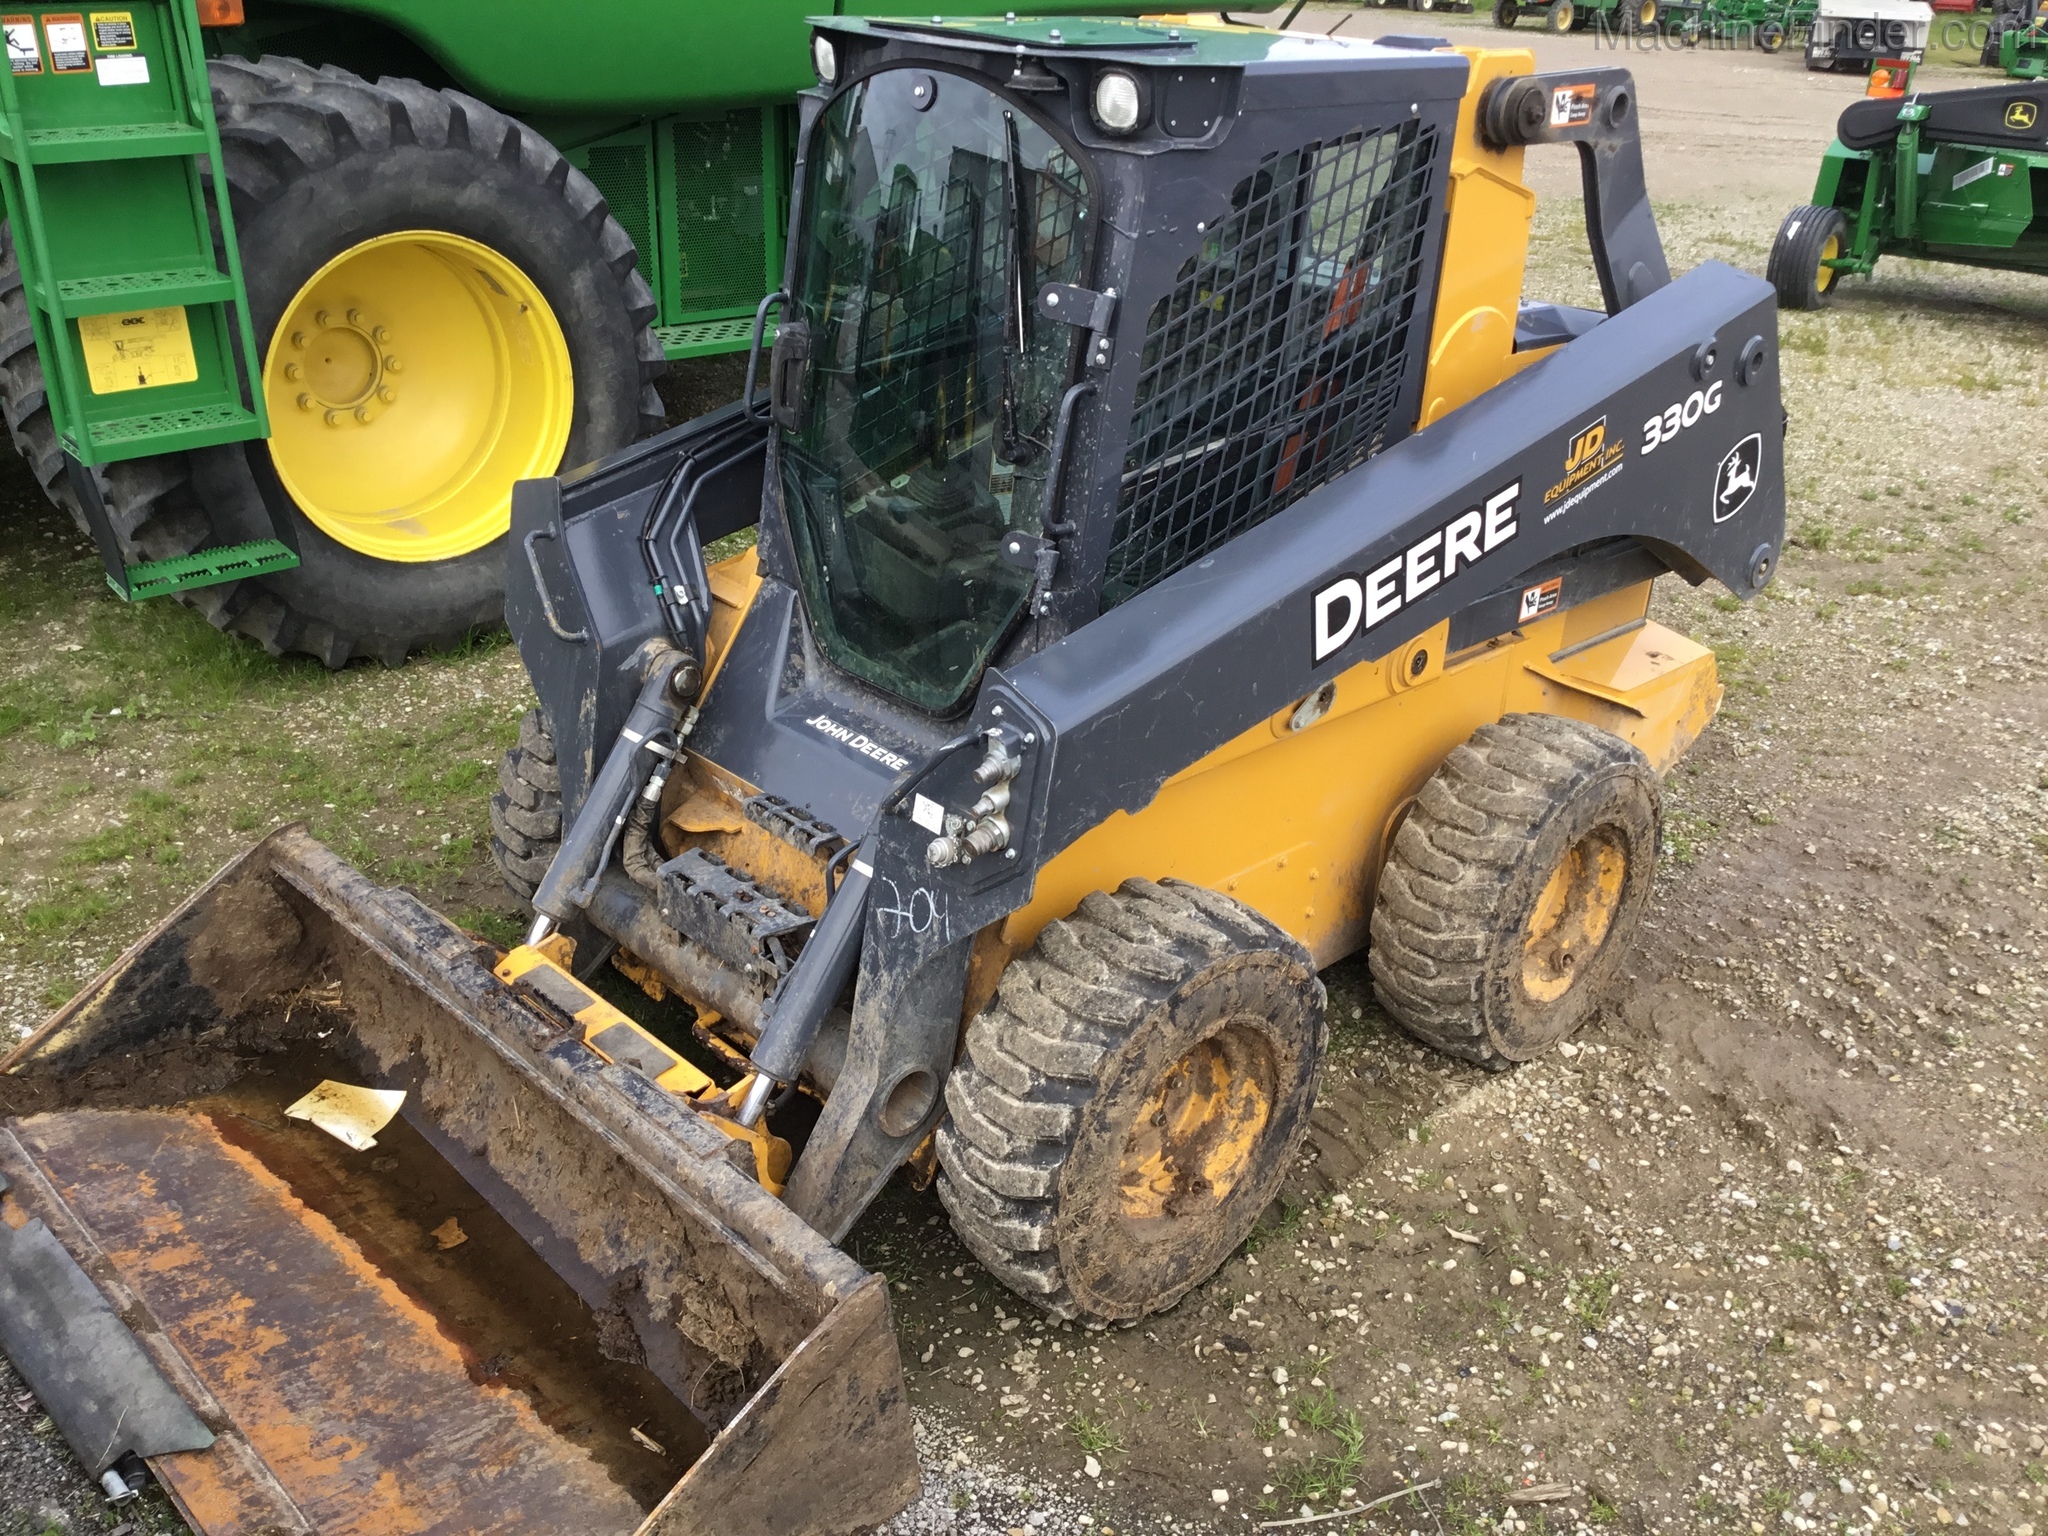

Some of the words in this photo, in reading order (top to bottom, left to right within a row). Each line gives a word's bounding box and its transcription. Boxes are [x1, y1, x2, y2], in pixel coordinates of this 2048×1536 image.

[1565, 425, 1605, 472] JD
[1641, 380, 1723, 455] 330G
[1543, 462, 1623, 525] www.jdequipment.com
[1544, 453, 1604, 504] EQUIPMENT
[1605, 438, 1625, 460] INC.
[1314, 482, 1520, 661] DEERE
[806, 715, 854, 742] JOHN
[848, 735, 909, 771] DEERE
